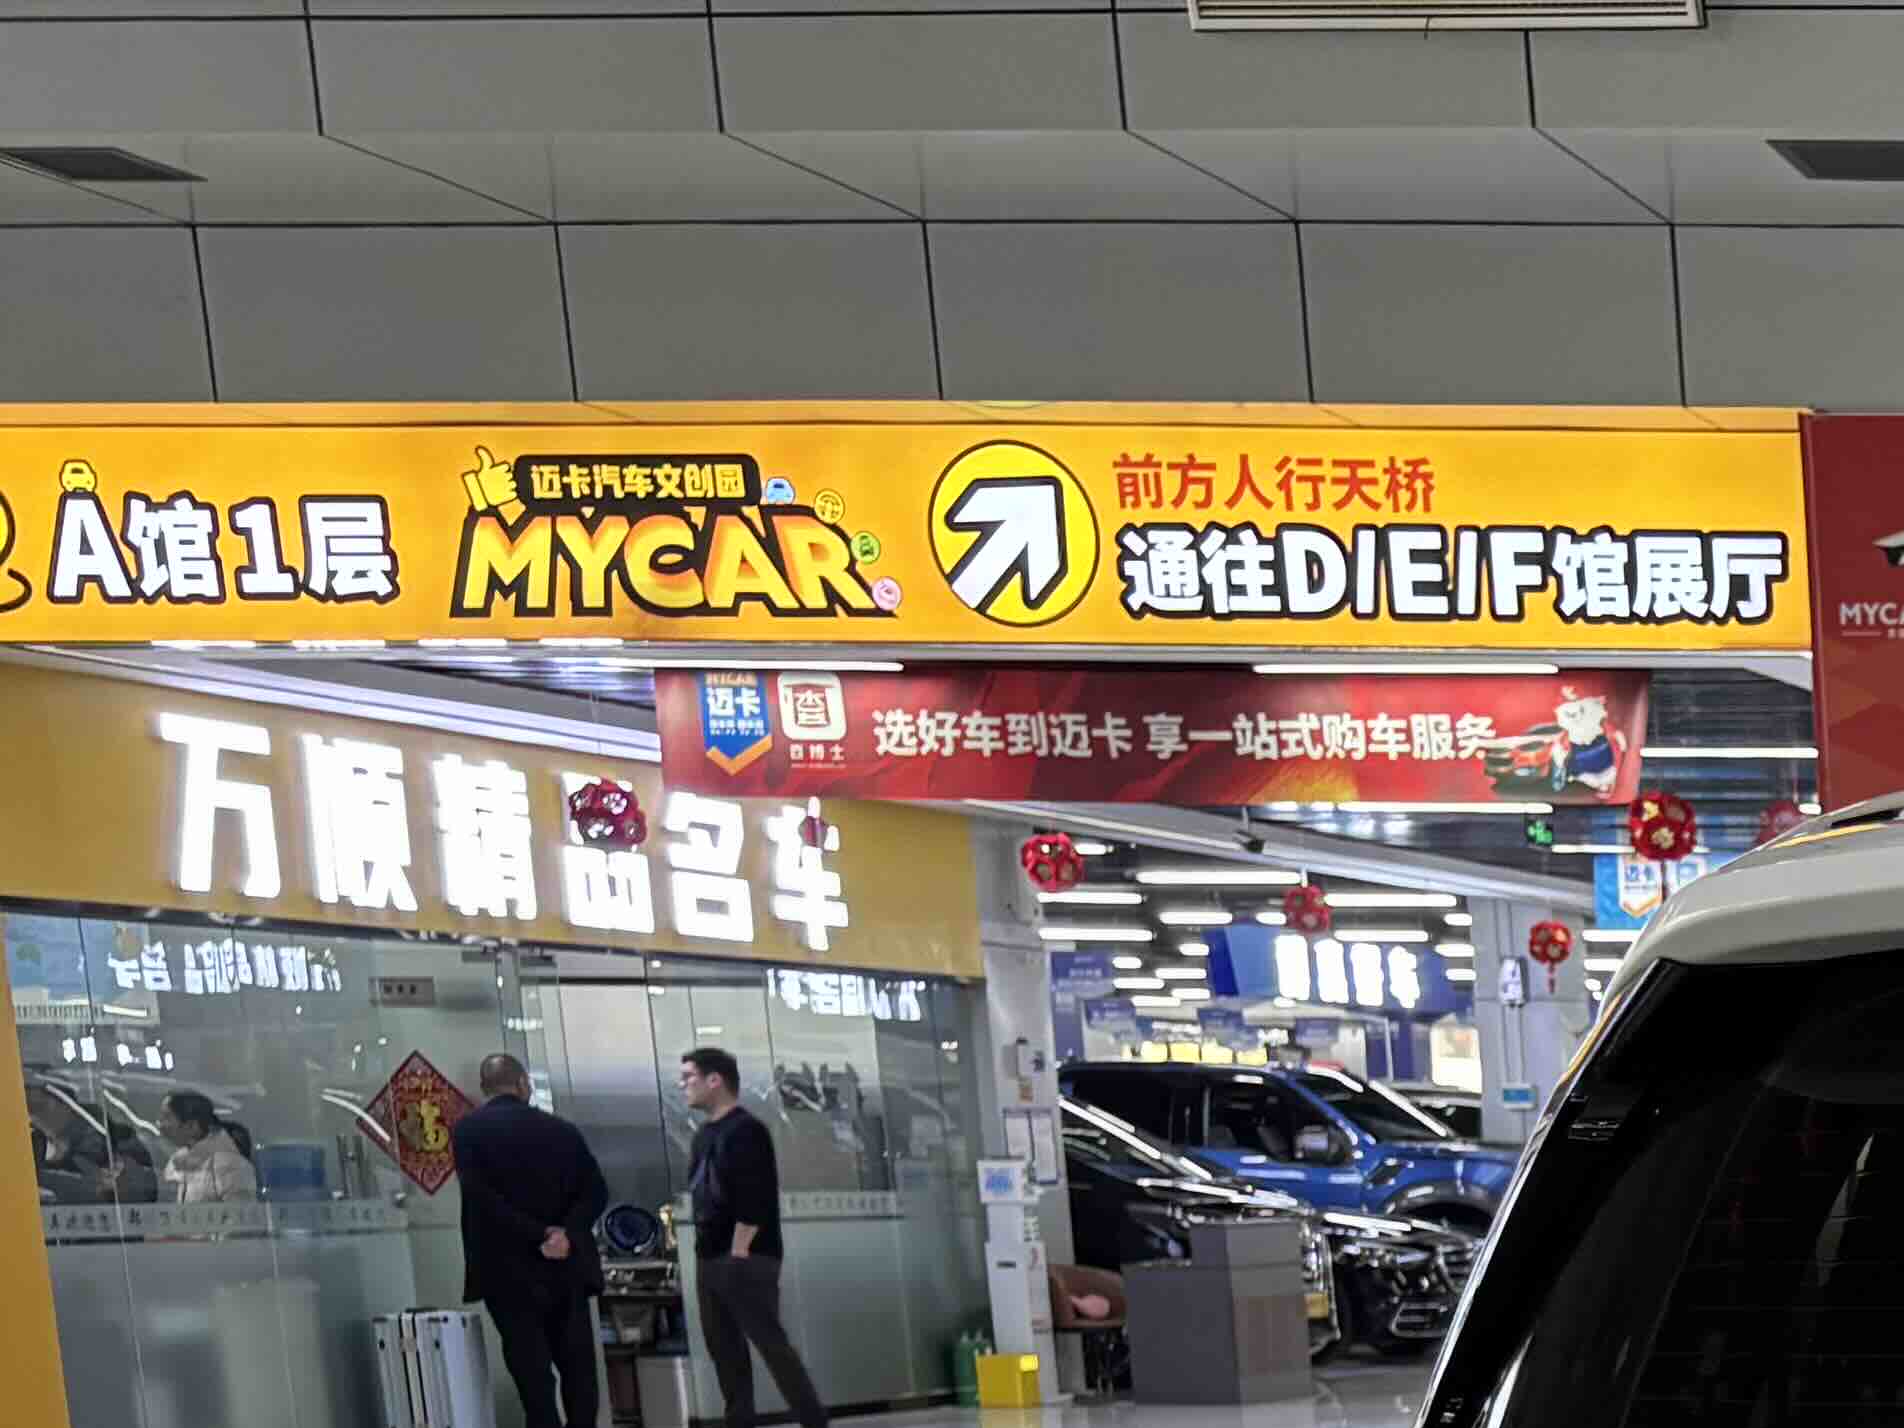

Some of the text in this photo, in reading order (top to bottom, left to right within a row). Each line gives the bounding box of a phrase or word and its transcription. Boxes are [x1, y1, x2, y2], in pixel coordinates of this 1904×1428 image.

[531, 464, 745, 499] 迈卡汽车文创园
[1113, 454, 1436, 513] 前方人行天桥
[50, 494, 398, 602] A馆1层
[456, 510, 884, 614] MYCAR
[871, 709, 1497, 760] 选好车到迈卡 享一站式购车服务
[159, 712, 849, 951] 万顺精品名车
